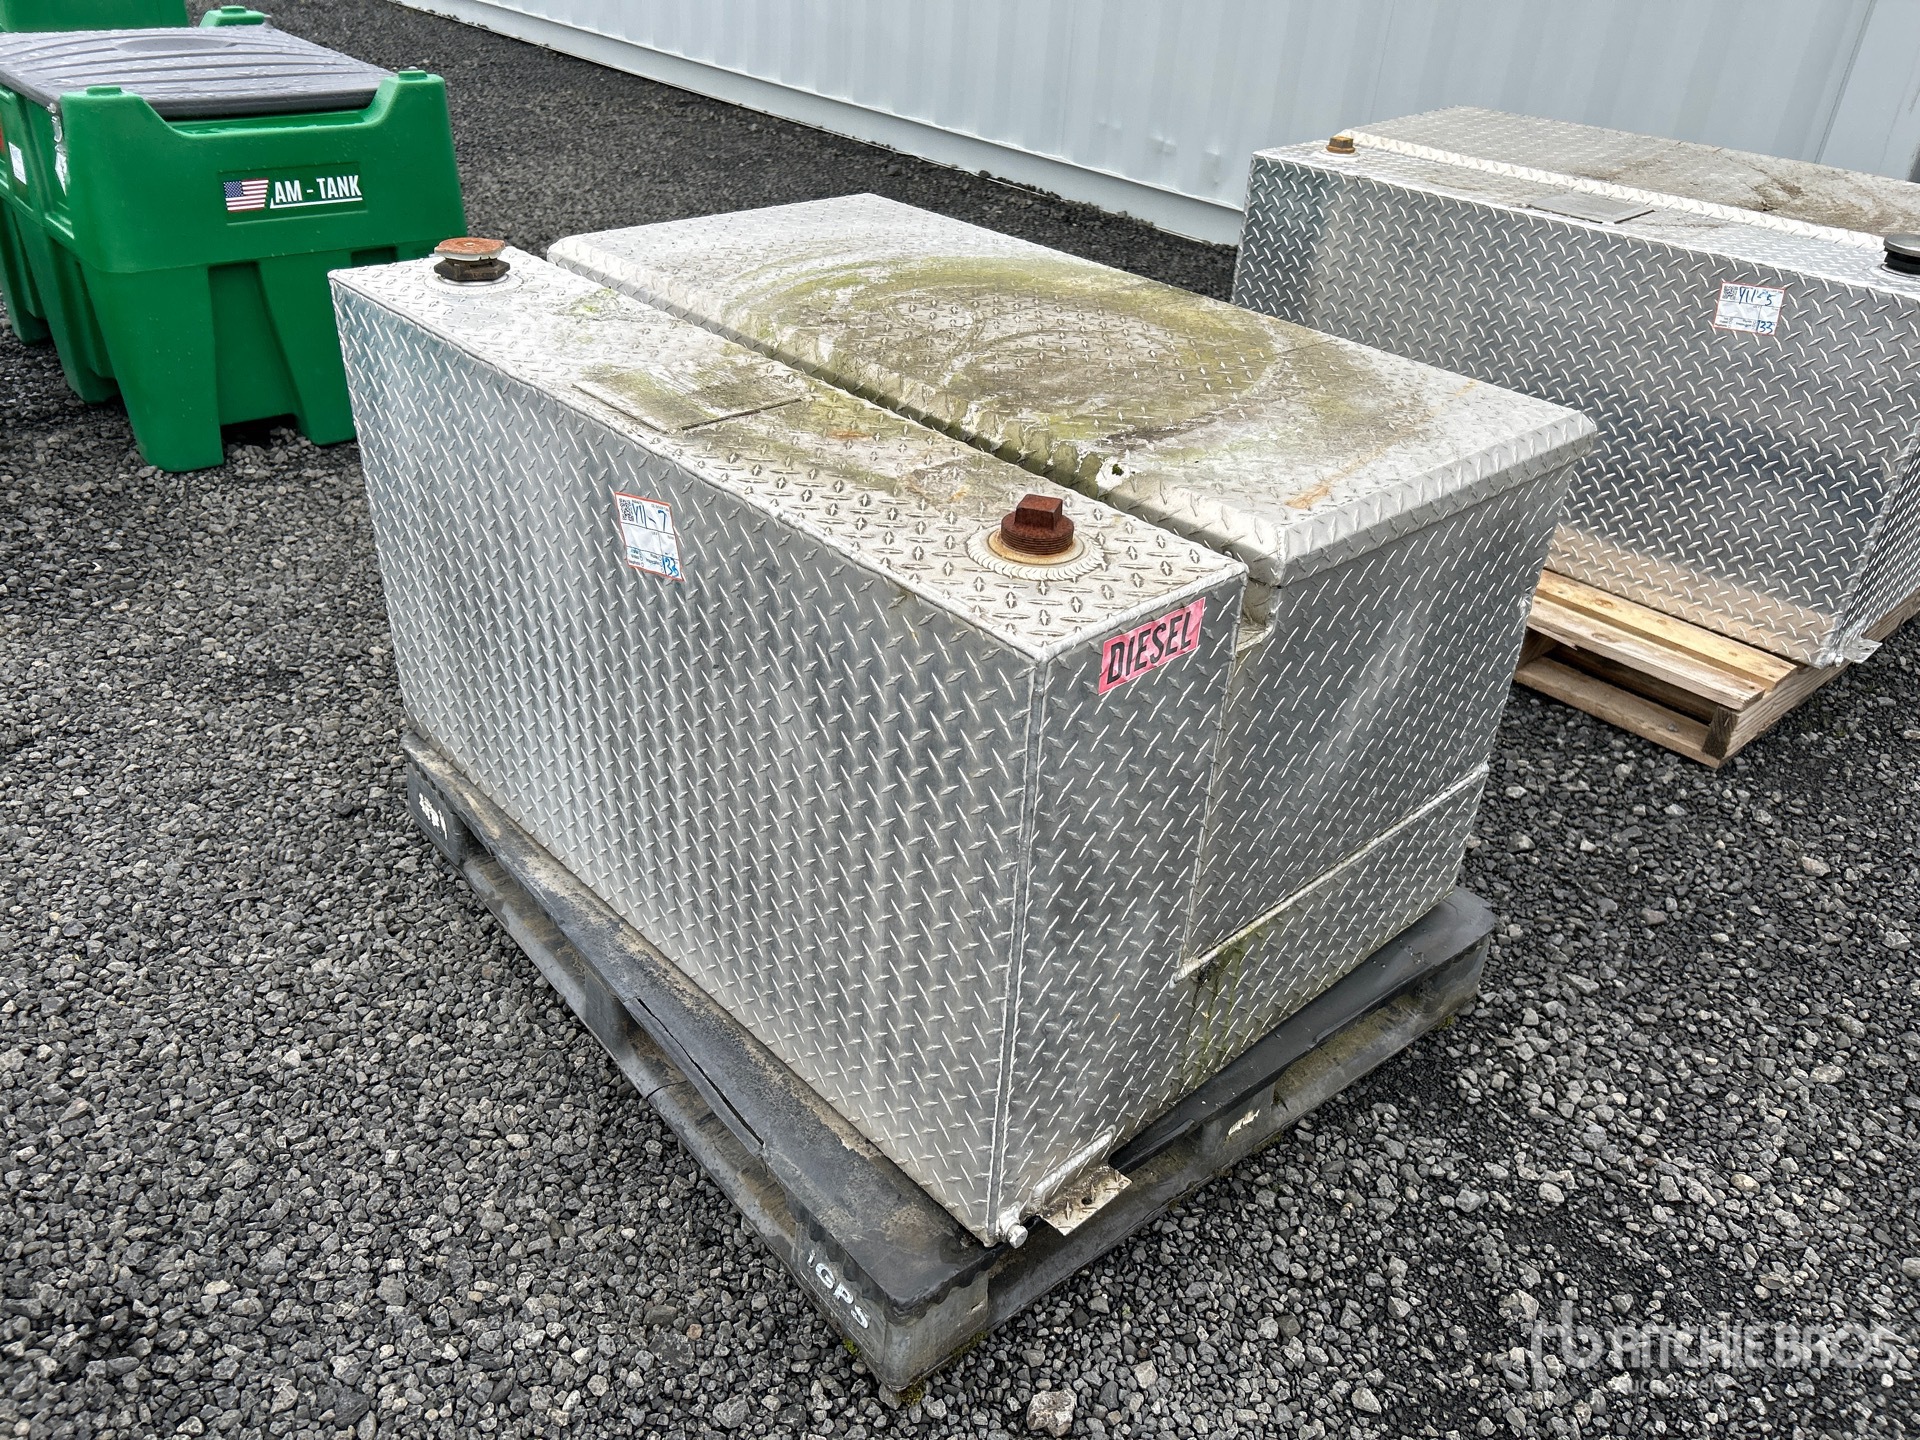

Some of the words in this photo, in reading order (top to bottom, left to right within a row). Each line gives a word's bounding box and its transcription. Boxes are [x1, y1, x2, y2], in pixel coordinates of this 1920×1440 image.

[274, 180, 302, 204] AM
[316, 174, 362, 200] TANK
[1107, 610, 1192, 685] DIESEL
